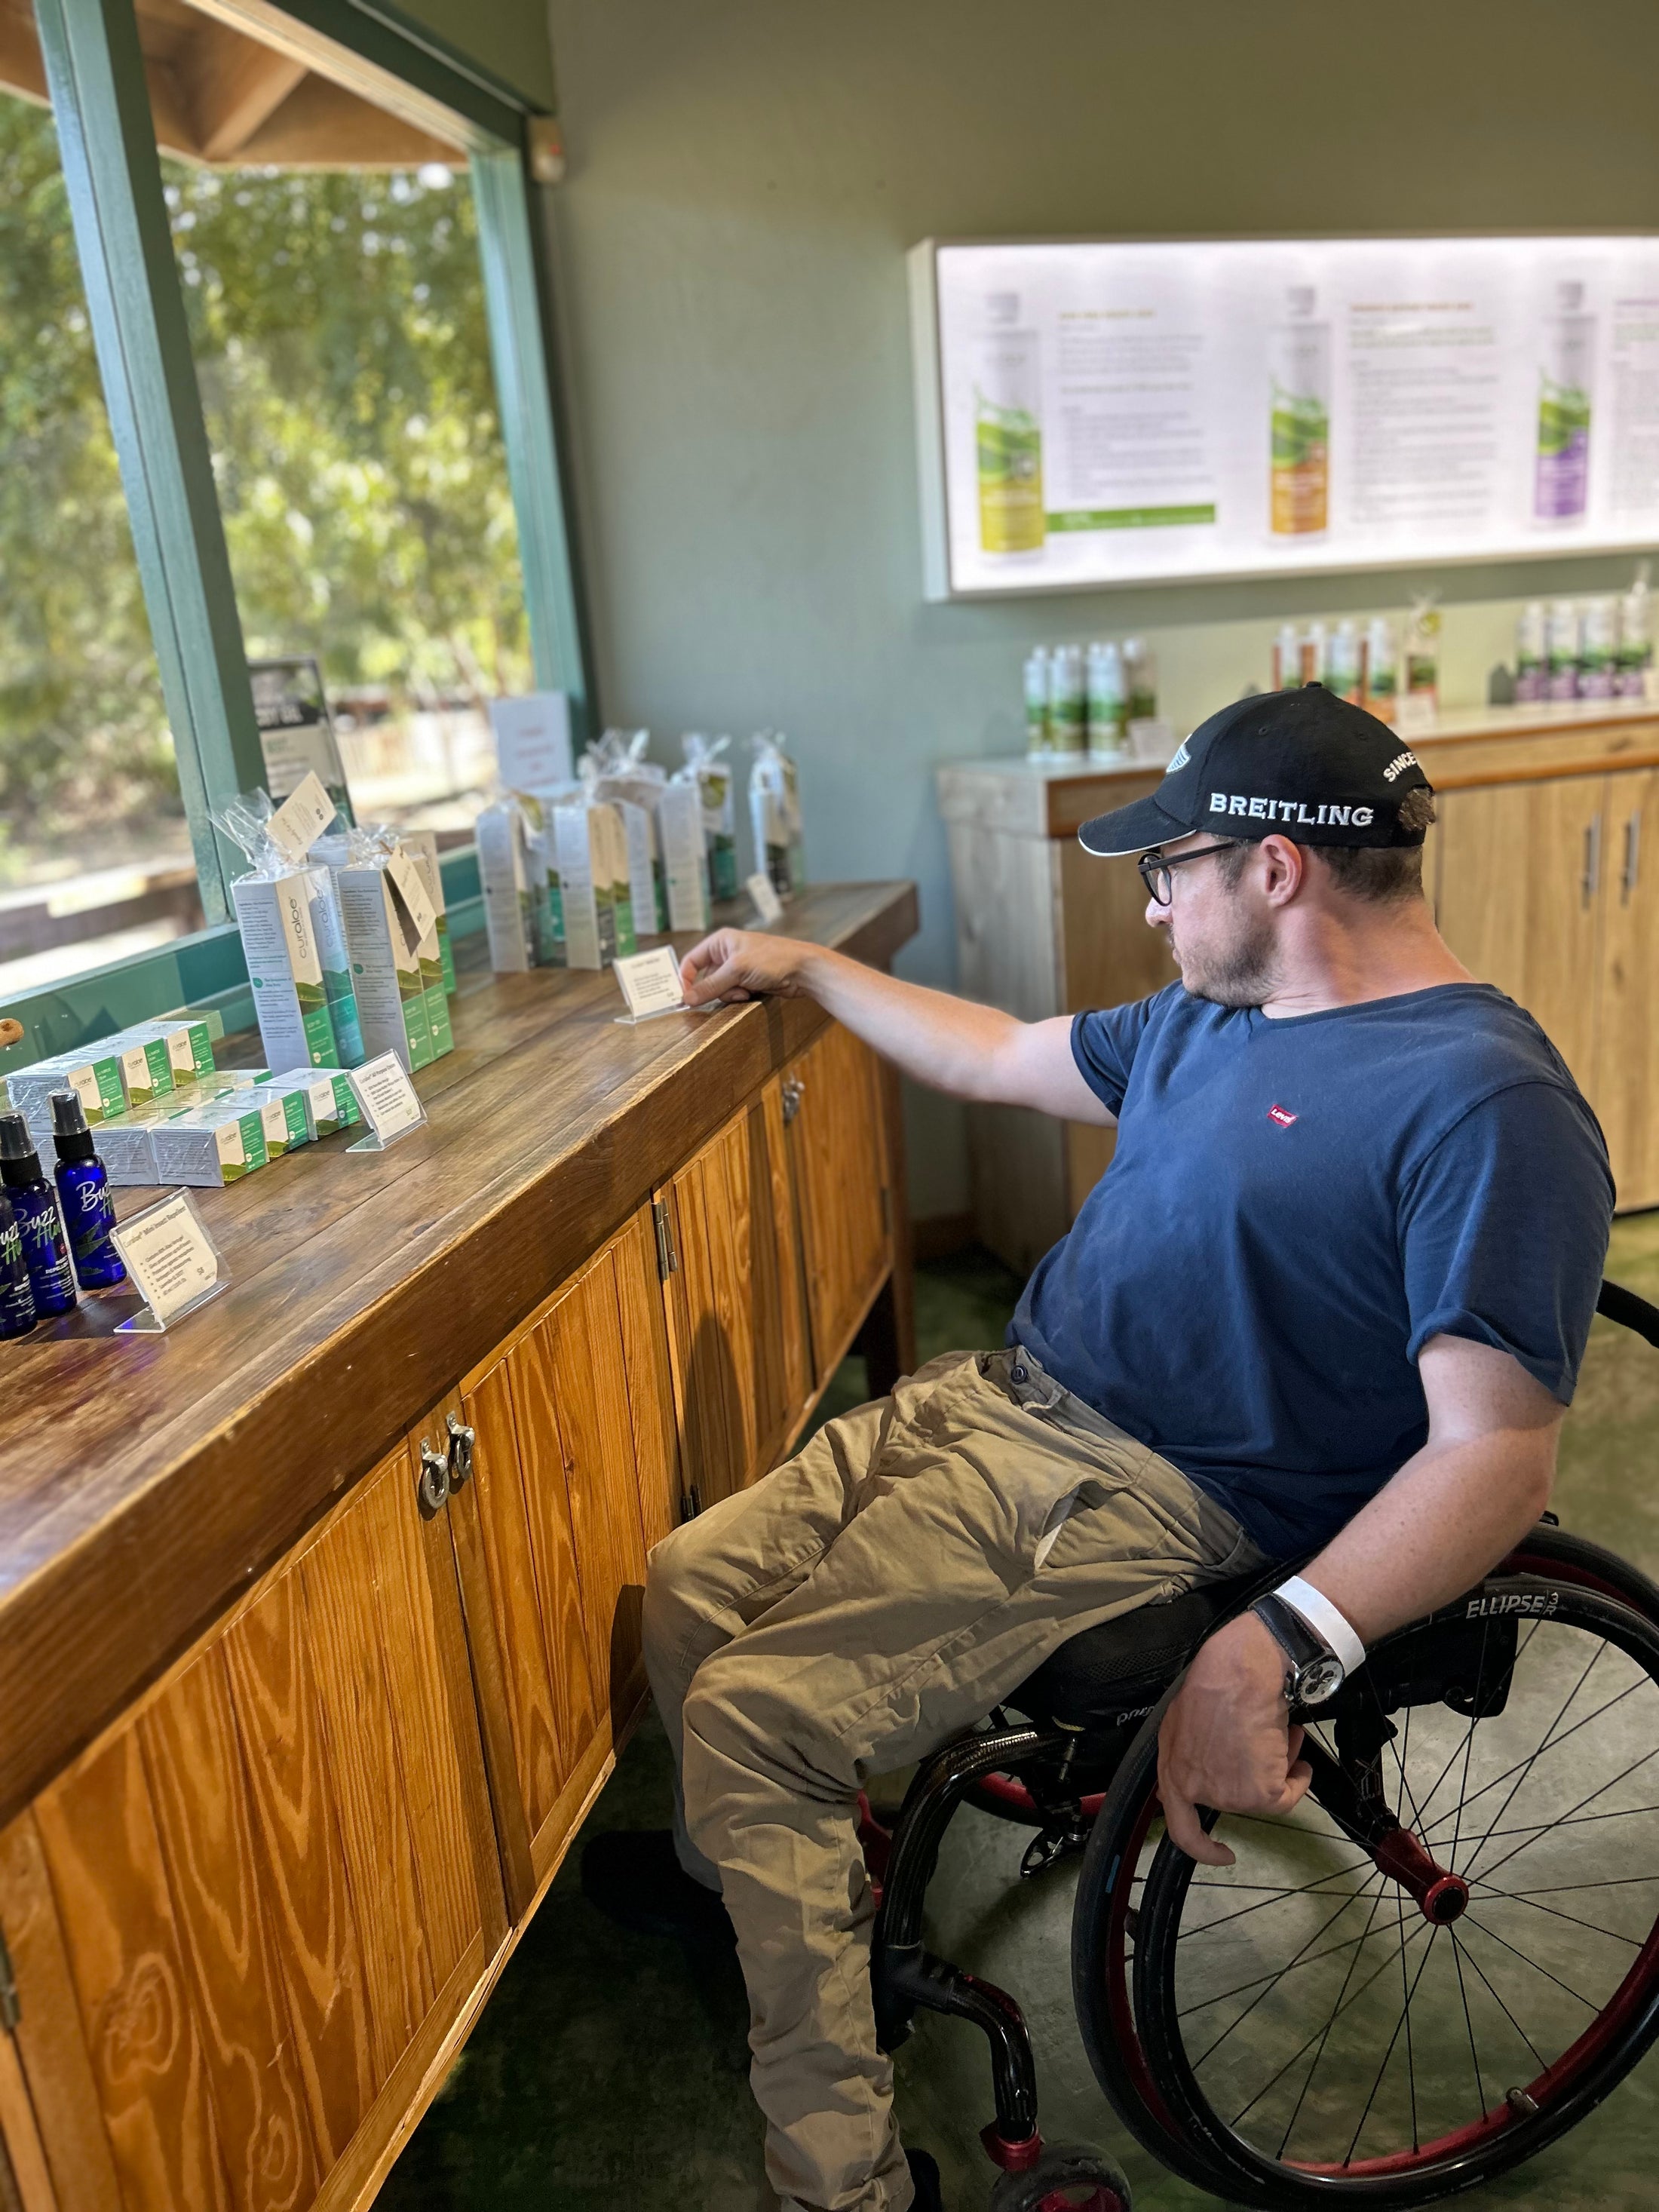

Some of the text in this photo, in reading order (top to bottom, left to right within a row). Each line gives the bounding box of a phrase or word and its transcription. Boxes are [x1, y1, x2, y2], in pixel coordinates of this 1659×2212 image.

[1383, 752, 1417, 783] SINCE
[1209, 793, 1374, 827] BREITLING
[290, 897, 307, 959] curaloe
[1465, 1594, 1546, 1619] ELLIPSE
